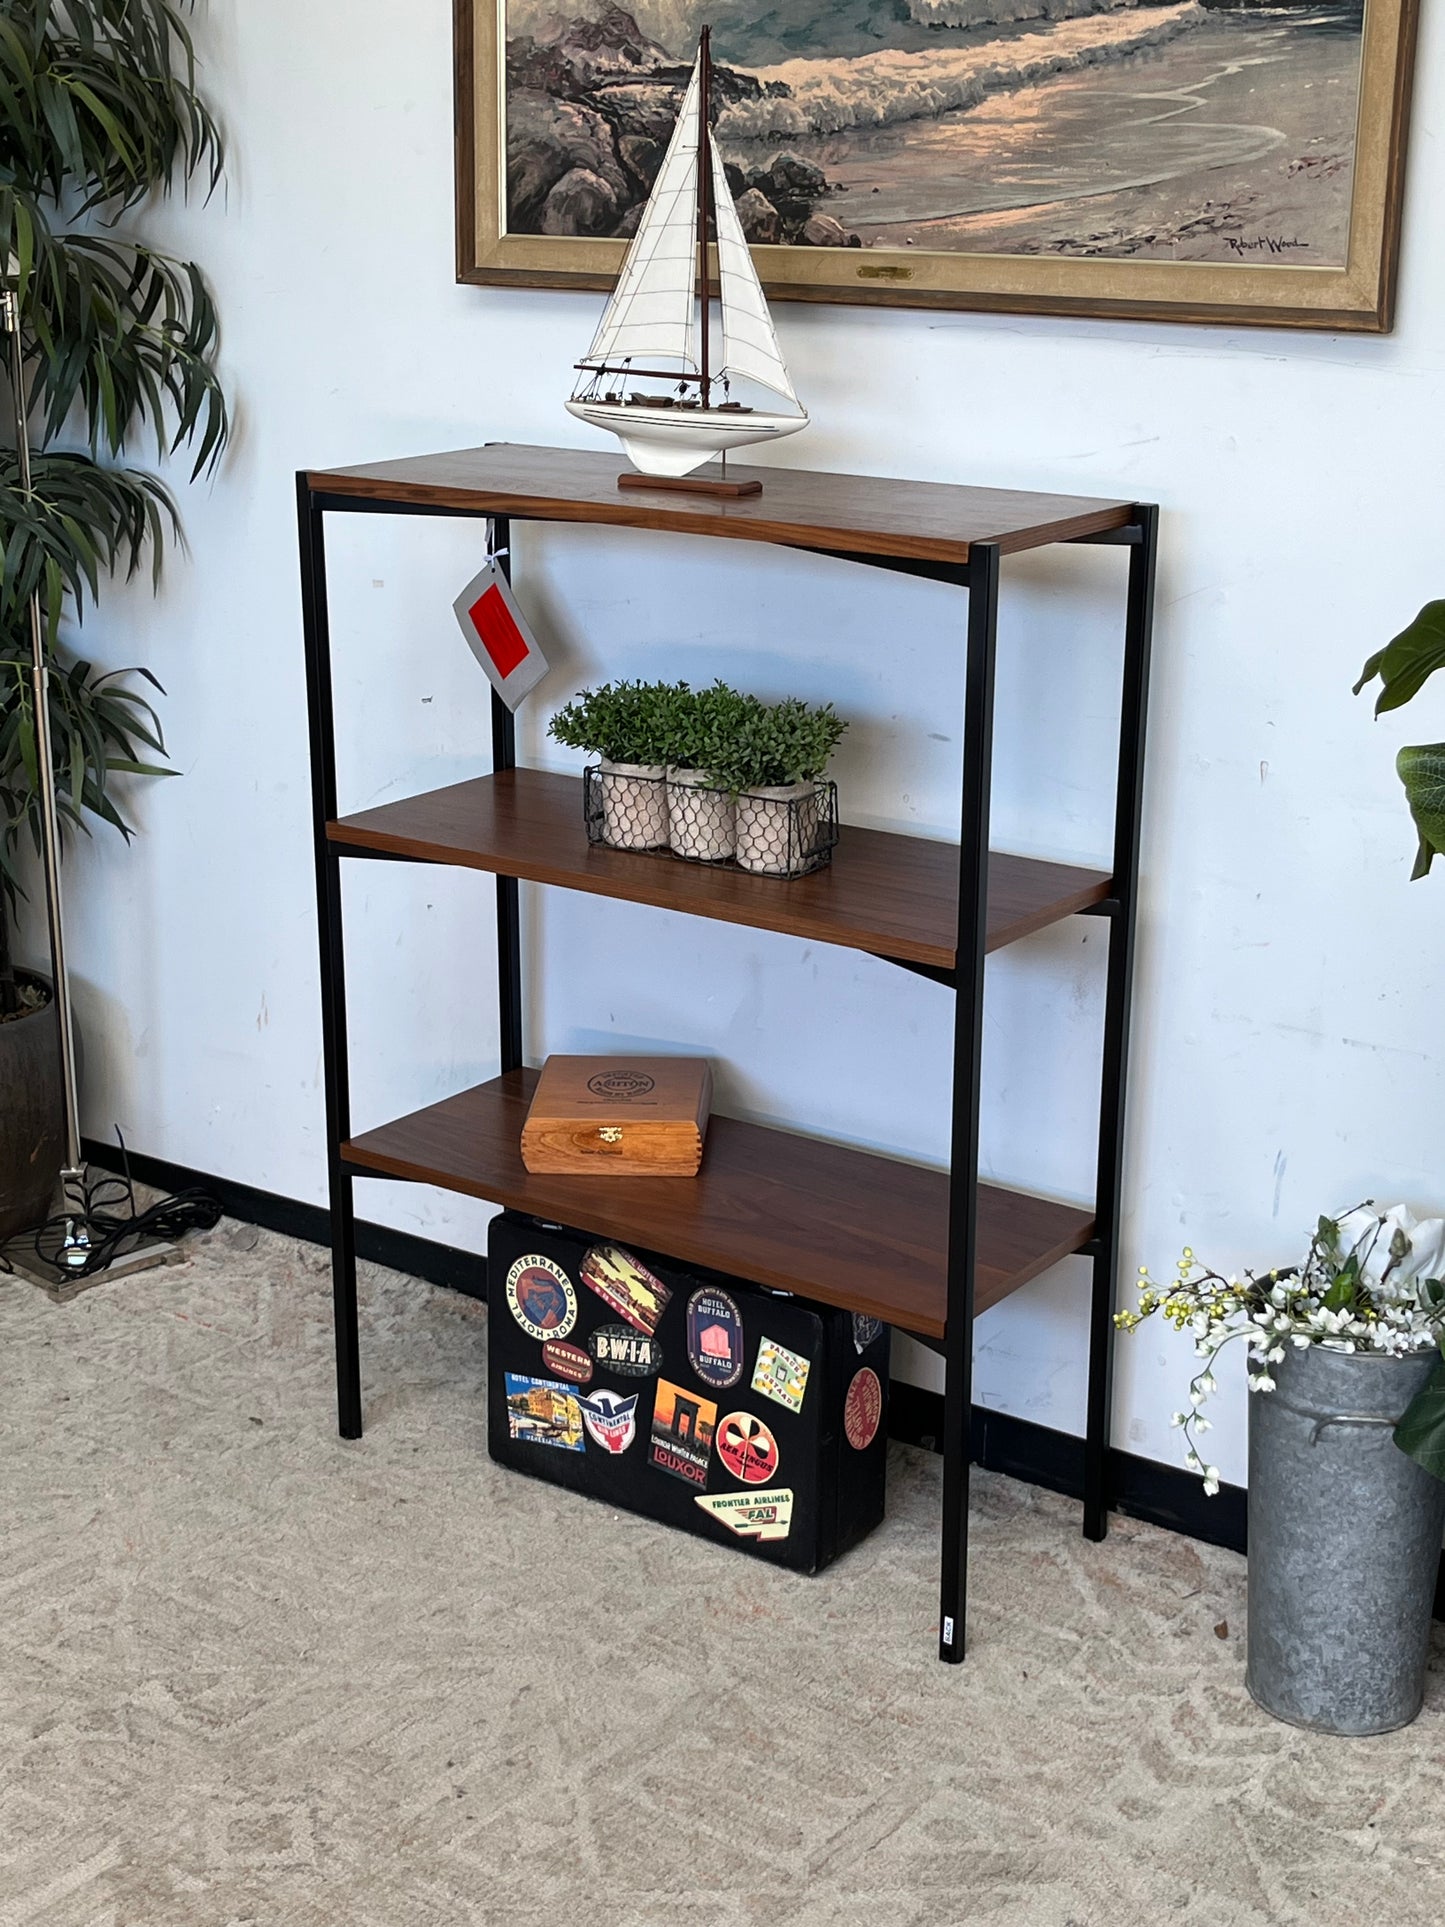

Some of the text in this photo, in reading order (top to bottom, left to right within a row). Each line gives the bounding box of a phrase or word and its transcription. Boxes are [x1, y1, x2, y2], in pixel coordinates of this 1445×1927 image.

[1266, 236, 1309, 253] Wood
[508, 1256, 576, 1339] HOTEL MEDITERRANEO ROMA
[702, 1297, 726, 1309] HOTEL
[697, 1304, 731, 1319] BUFFALO
[546, 1344, 591, 1367] WESTERN
[699, 1354, 732, 1369] BUFFALO
[770, 1344, 800, 1373] PALACE
[551, 1362, 582, 1379] AIRLINES
[511, 1374, 570, 1391] HOTEL CONTINENTAL
[589, 1411, 630, 1427] CONTINENTAL
[653, 1446, 706, 1484] LOUXOR
[720, 1442, 774, 1472] AER LINGUS
[712, 1494, 790, 1508] FRONTIER AIRLINES
[748, 1508, 773, 1520] FAL
